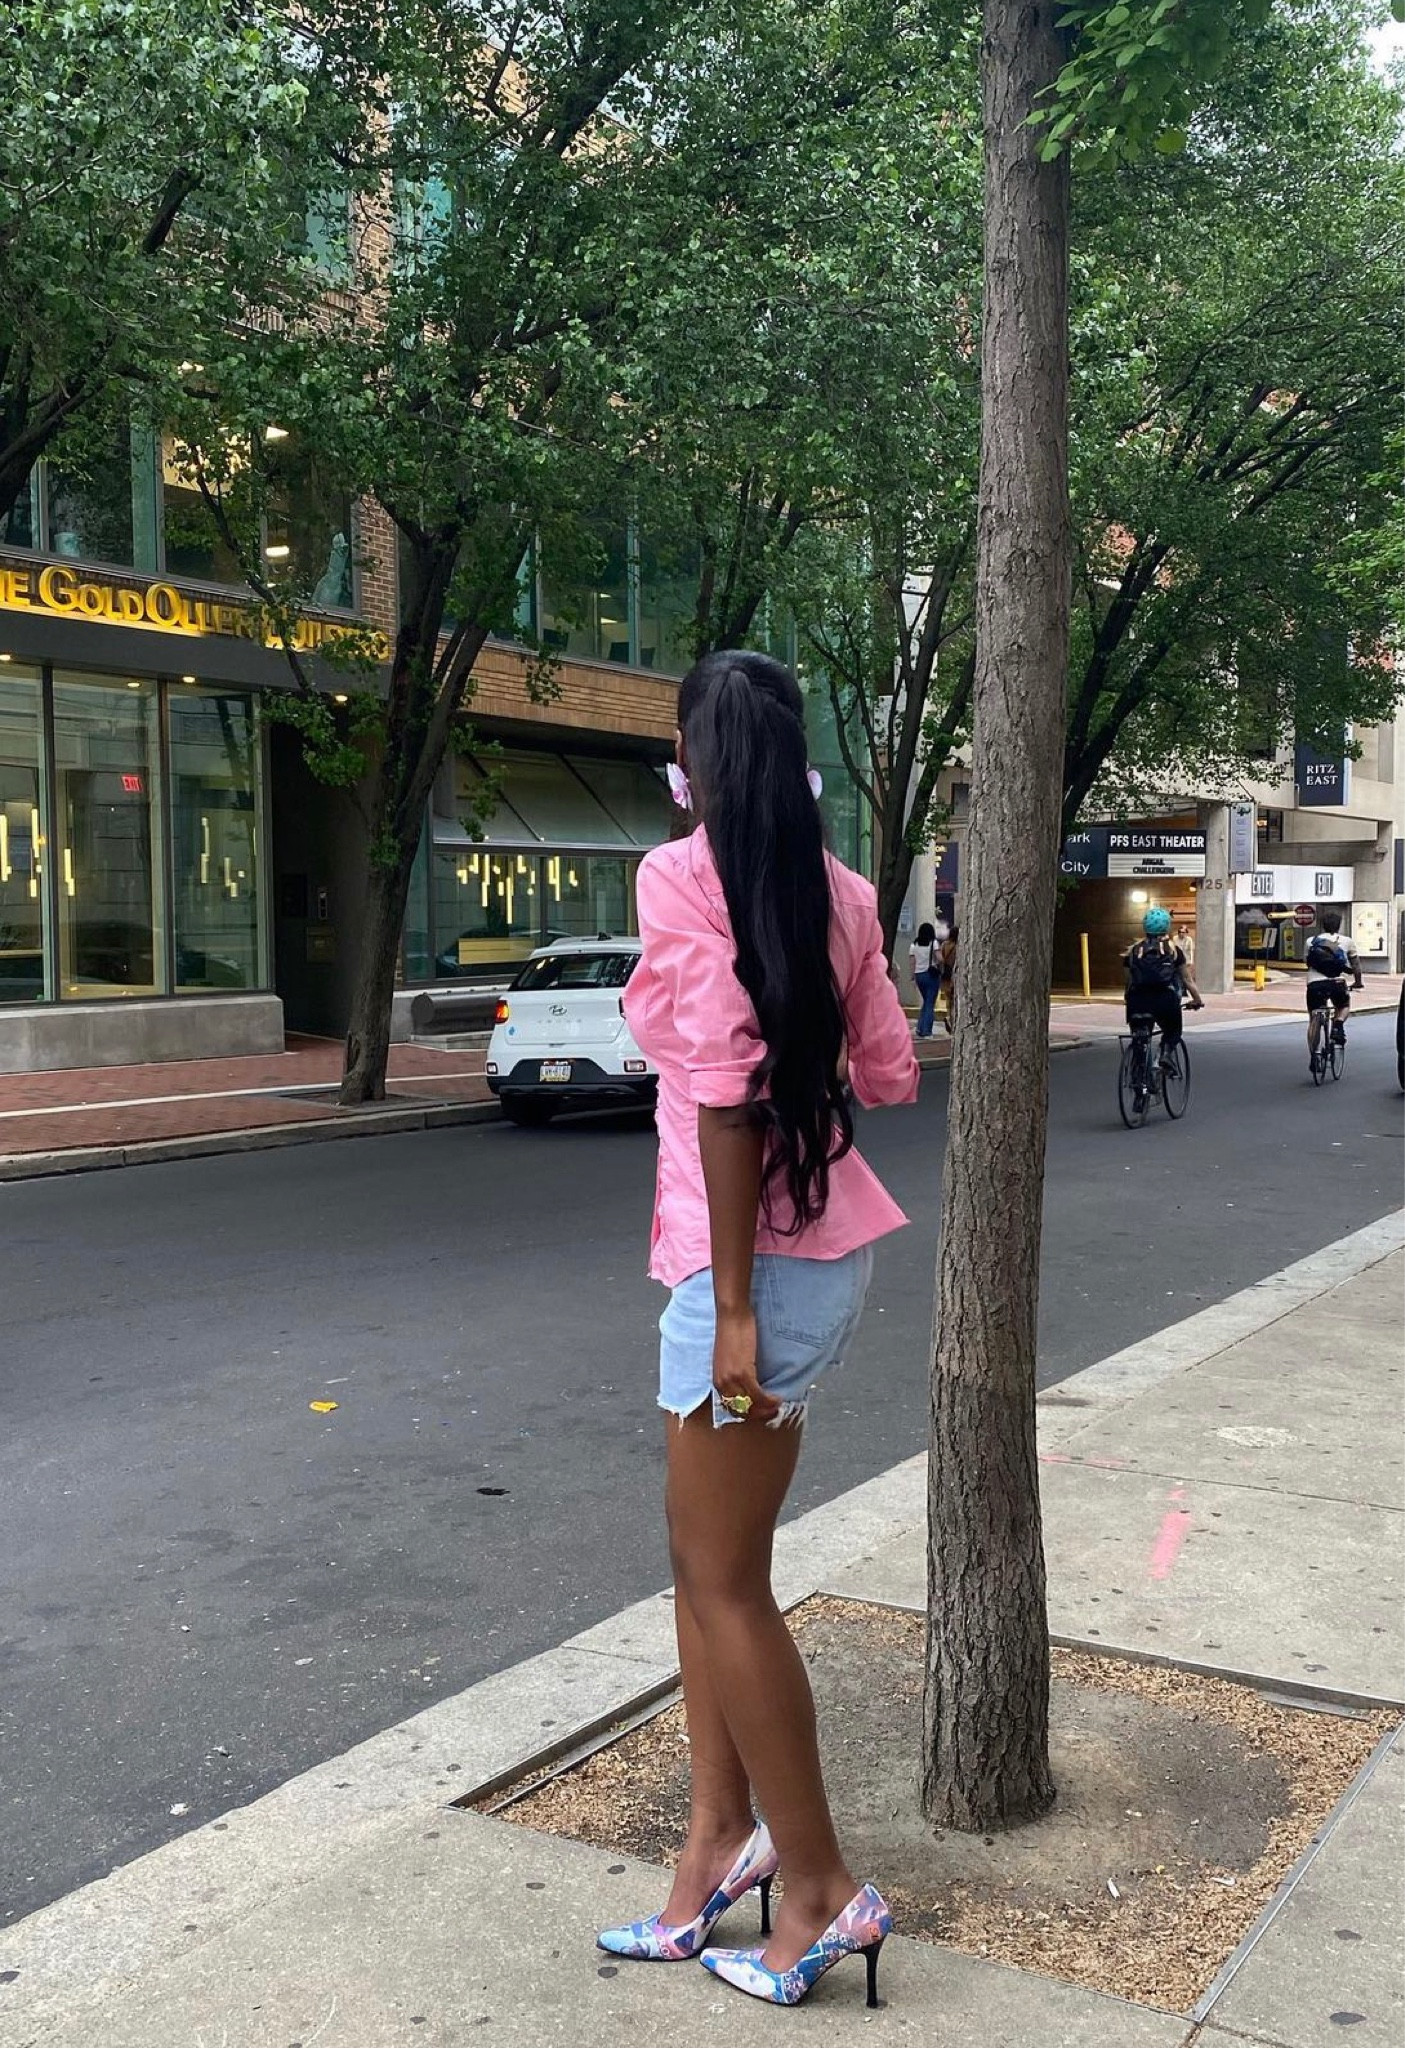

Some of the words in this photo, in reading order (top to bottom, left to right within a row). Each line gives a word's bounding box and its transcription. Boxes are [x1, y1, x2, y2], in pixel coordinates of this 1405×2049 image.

[0, 569, 30, 606] E
[1306, 764, 1335, 774] RITZ
[1306, 775, 1338, 786] EAST
[1067, 832, 1091, 843] ark
[1110, 834, 1129, 847] PFS
[1132, 834, 1157, 848] EAST
[1160, 834, 1204, 848] THEATER
[1061, 860, 1090, 875] City
